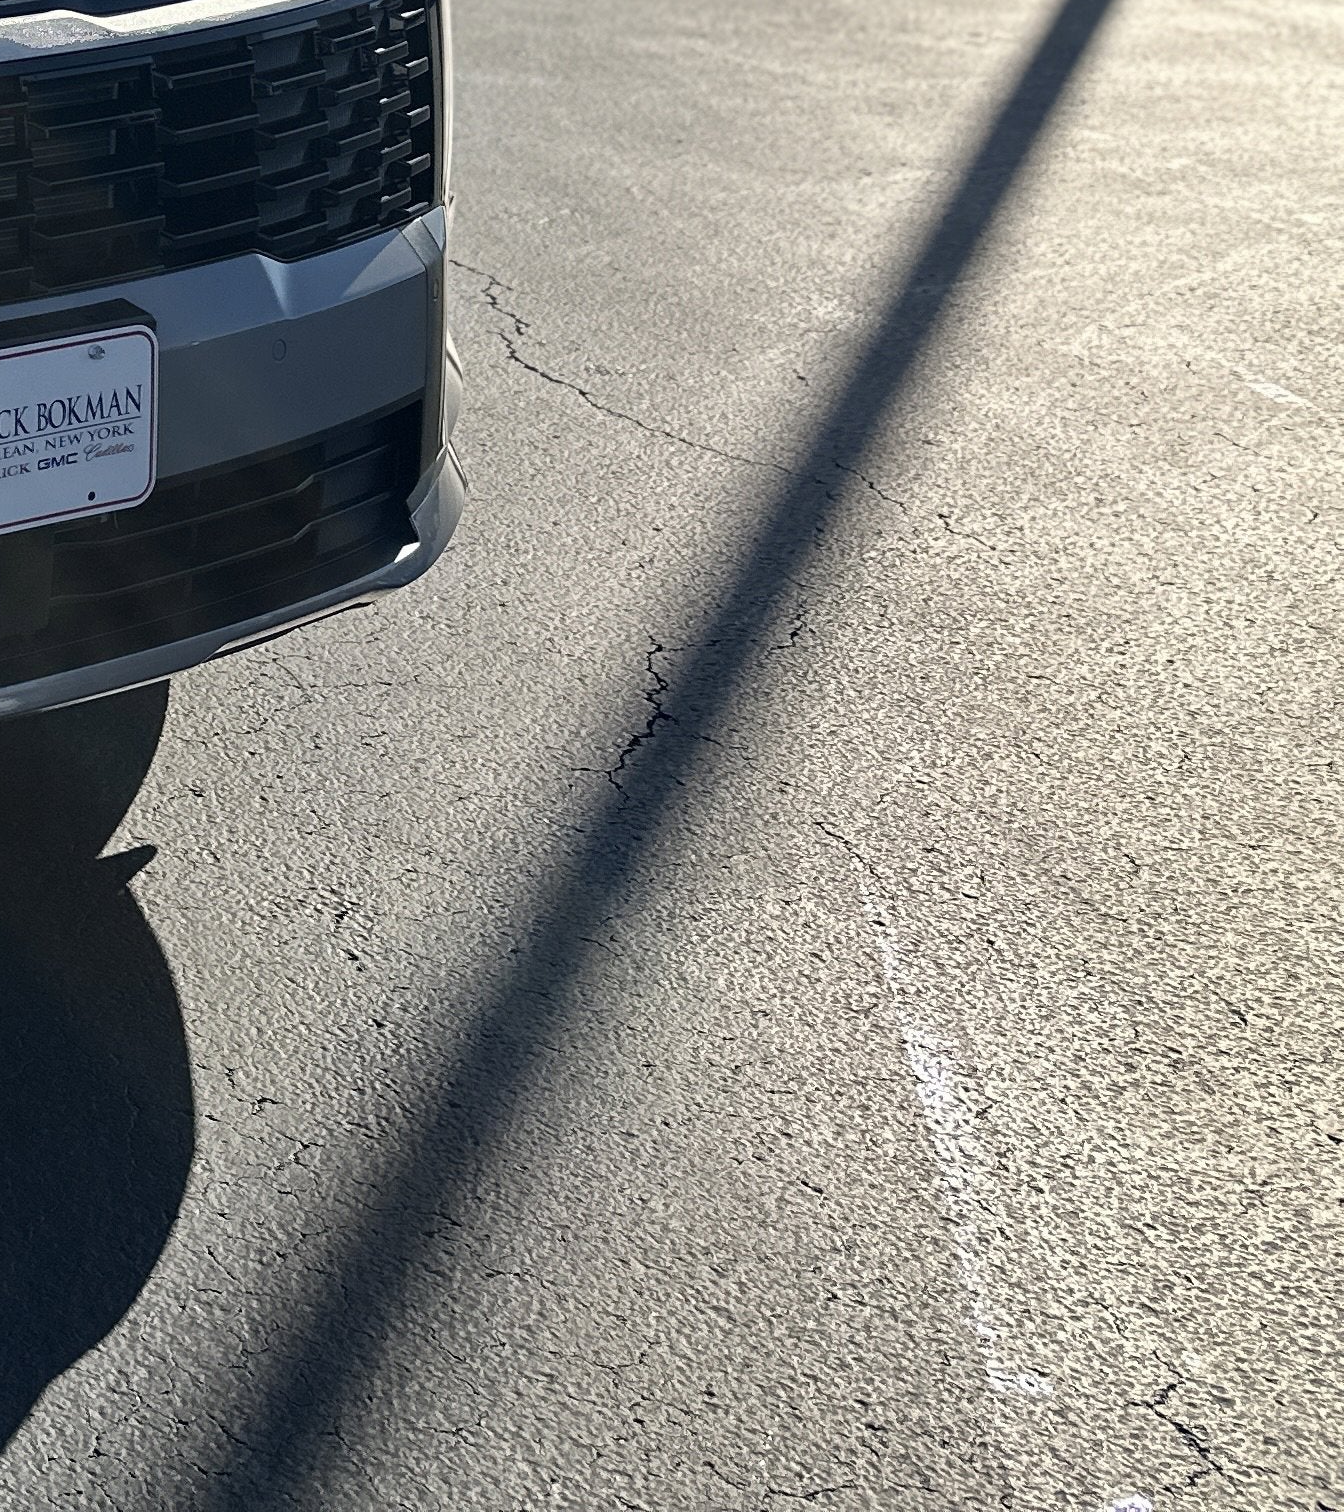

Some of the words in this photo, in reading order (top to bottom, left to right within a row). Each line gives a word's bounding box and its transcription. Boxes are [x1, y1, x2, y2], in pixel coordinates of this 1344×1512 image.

[35, 384, 143, 433] BOKMAN
[44, 432, 83, 451] NEW
[87, 422, 135, 443] YORK
[37, 452, 79, 471] GMC
